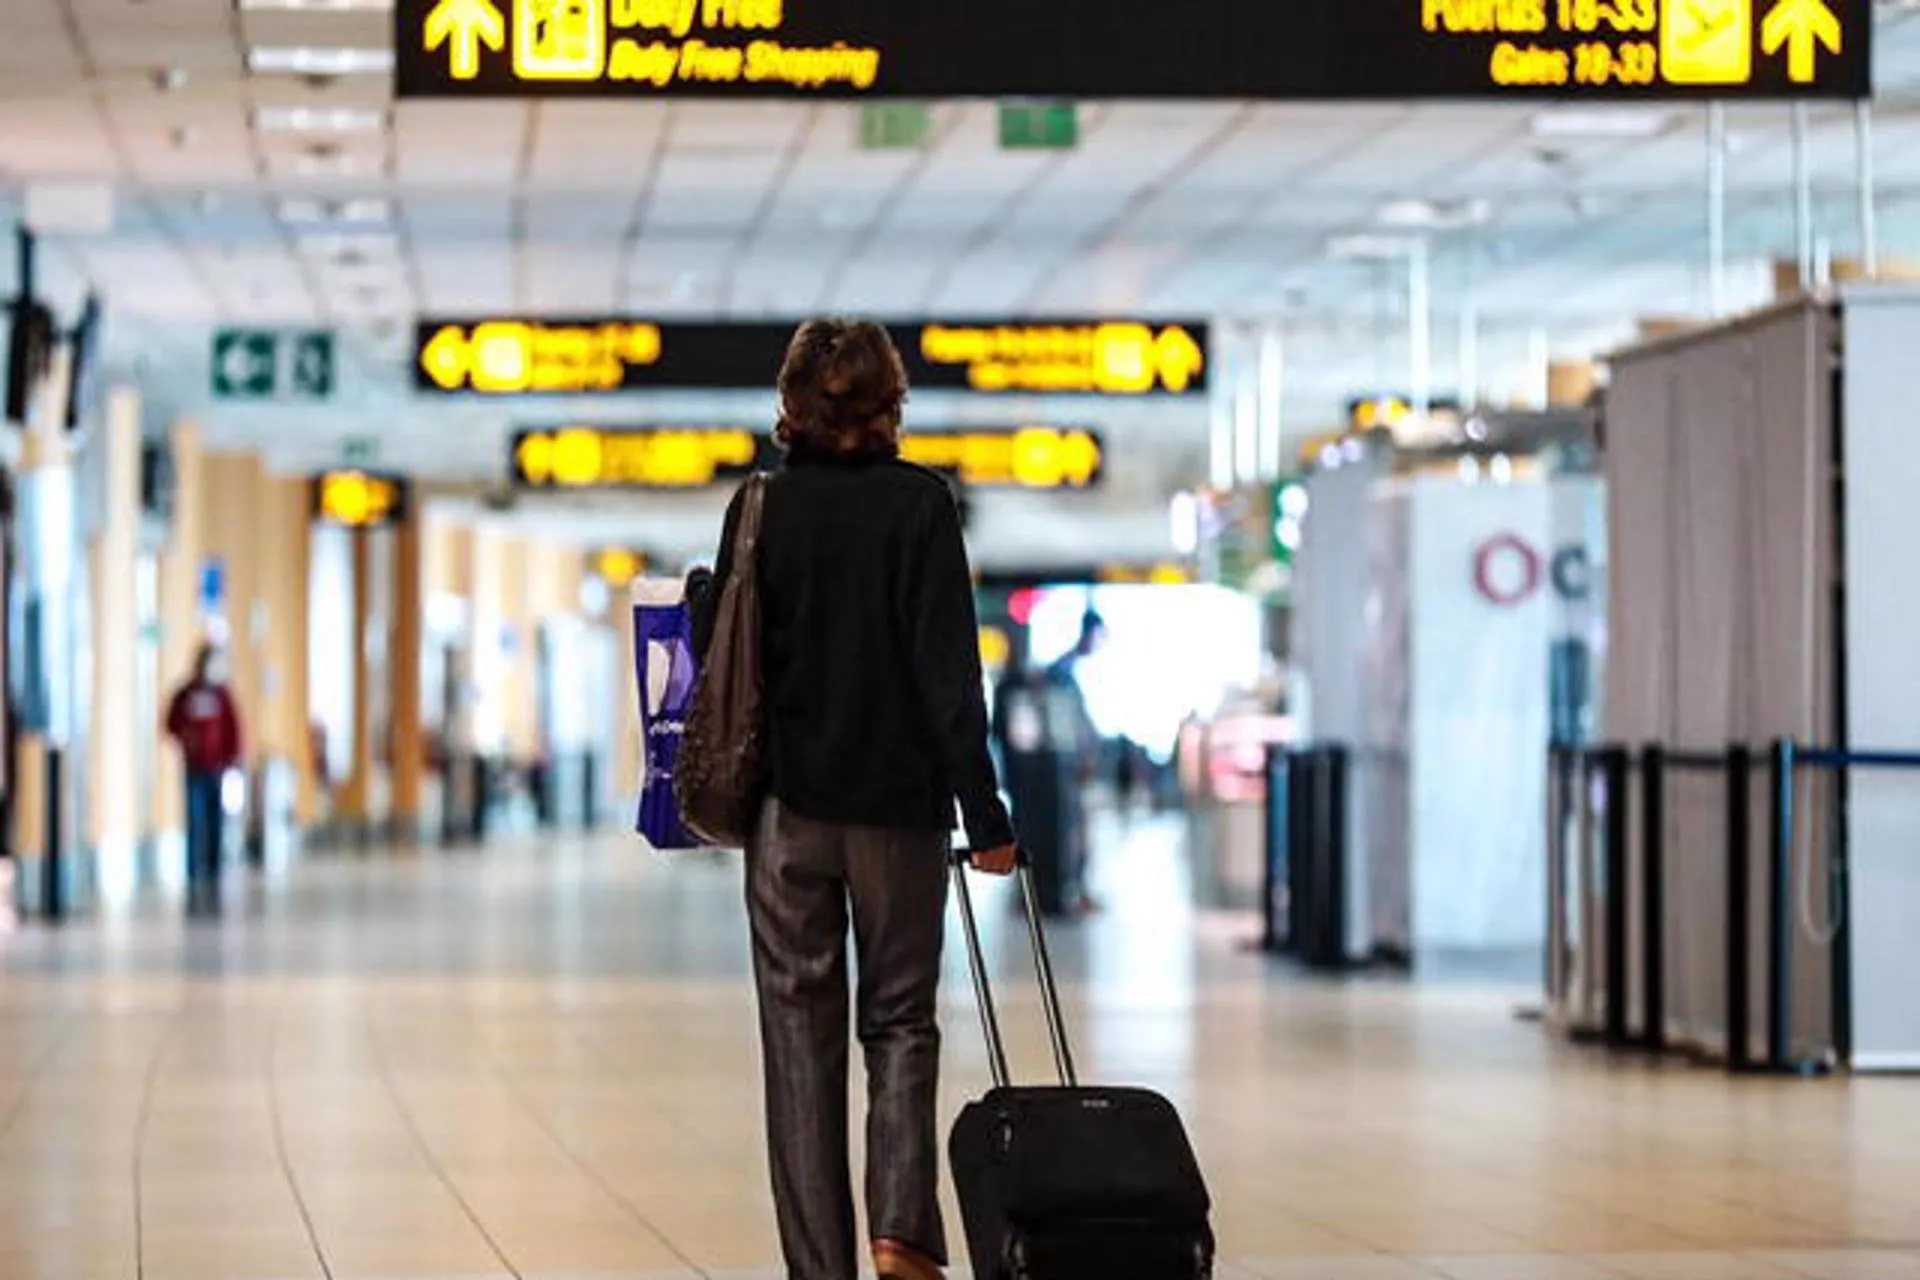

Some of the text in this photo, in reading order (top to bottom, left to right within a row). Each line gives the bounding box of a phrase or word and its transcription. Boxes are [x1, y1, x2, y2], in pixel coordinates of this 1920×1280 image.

[608, 39, 879, 88] Duty Free Shopping
[1491, 41, 1569, 85] Gates
